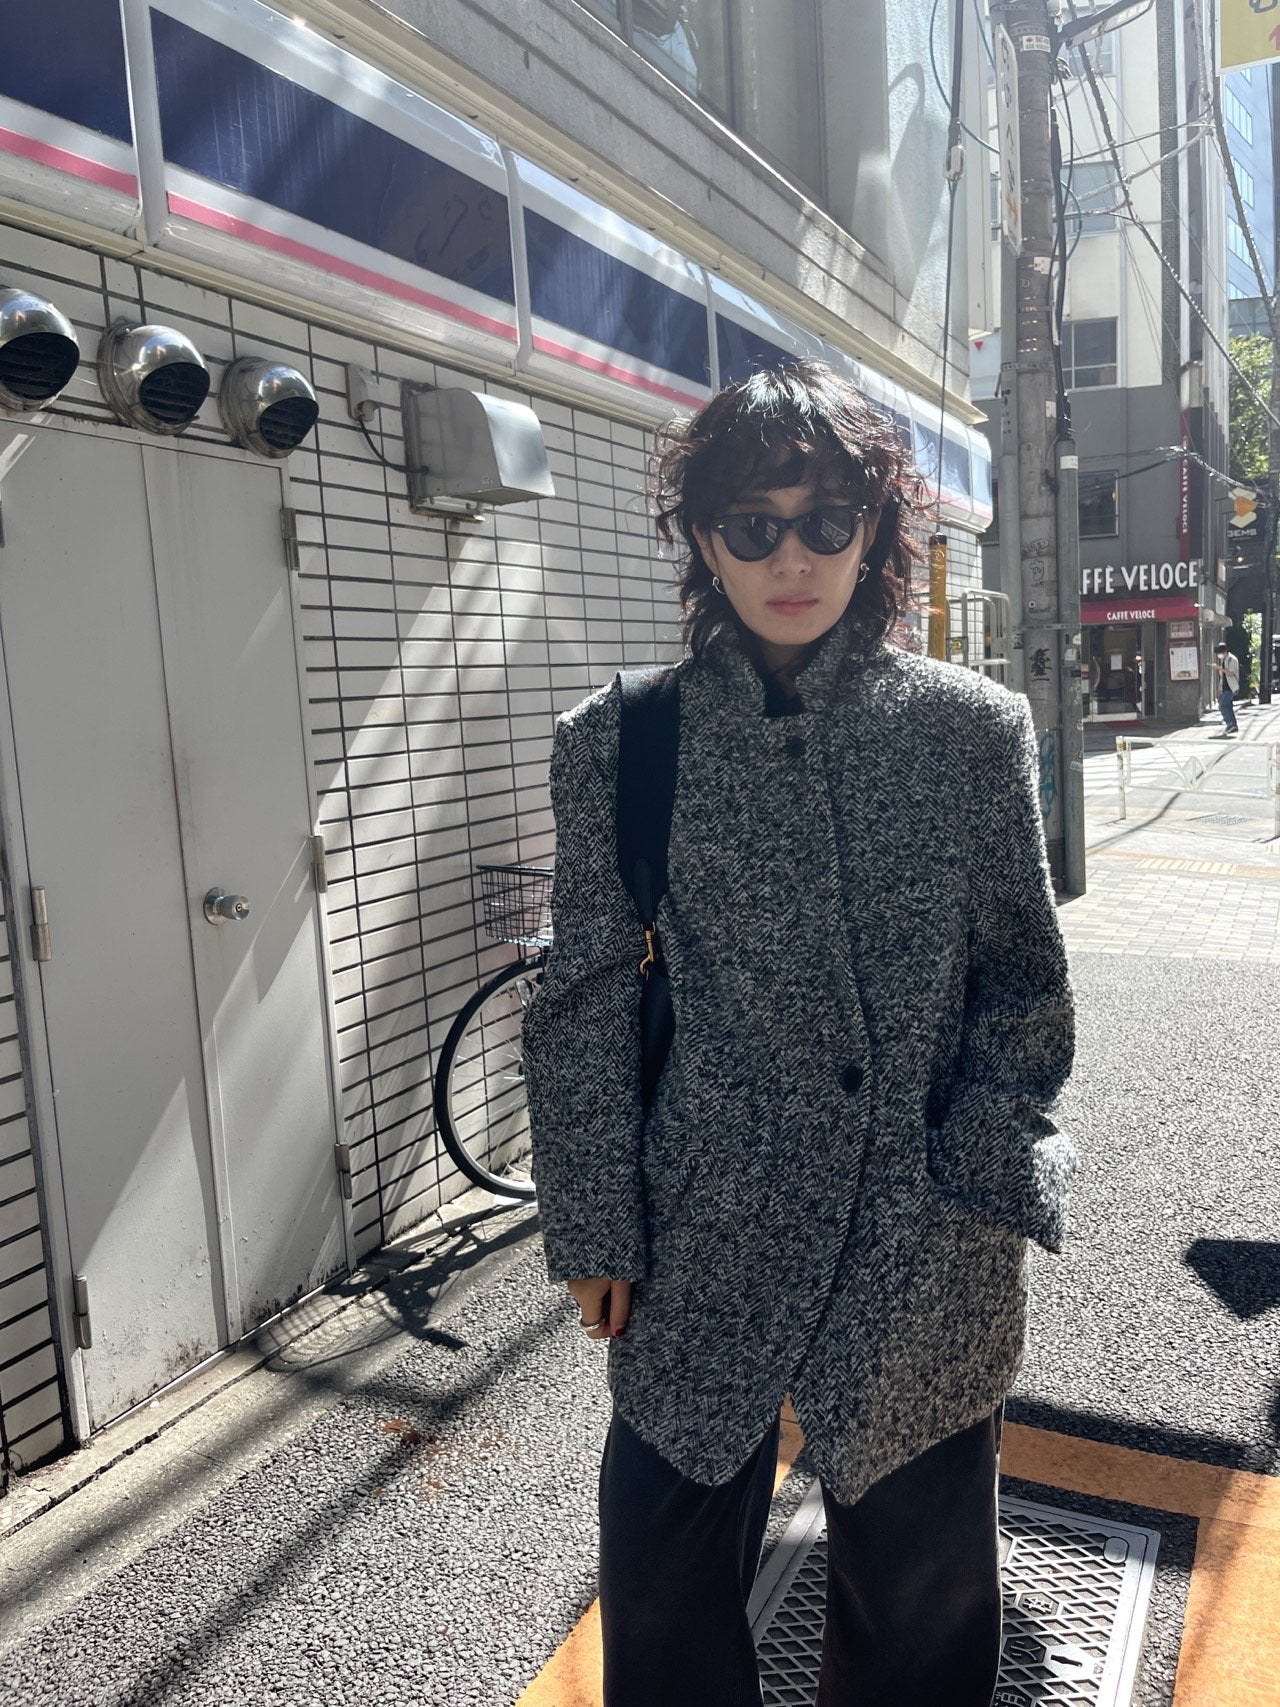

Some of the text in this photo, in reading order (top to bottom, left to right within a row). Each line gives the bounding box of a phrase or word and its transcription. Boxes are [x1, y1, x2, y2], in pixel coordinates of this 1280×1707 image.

[1079, 565, 1115, 595] FFÈ
[1121, 561, 1198, 591] VELOCE
[1129, 609, 1155, 620] VELOCE
